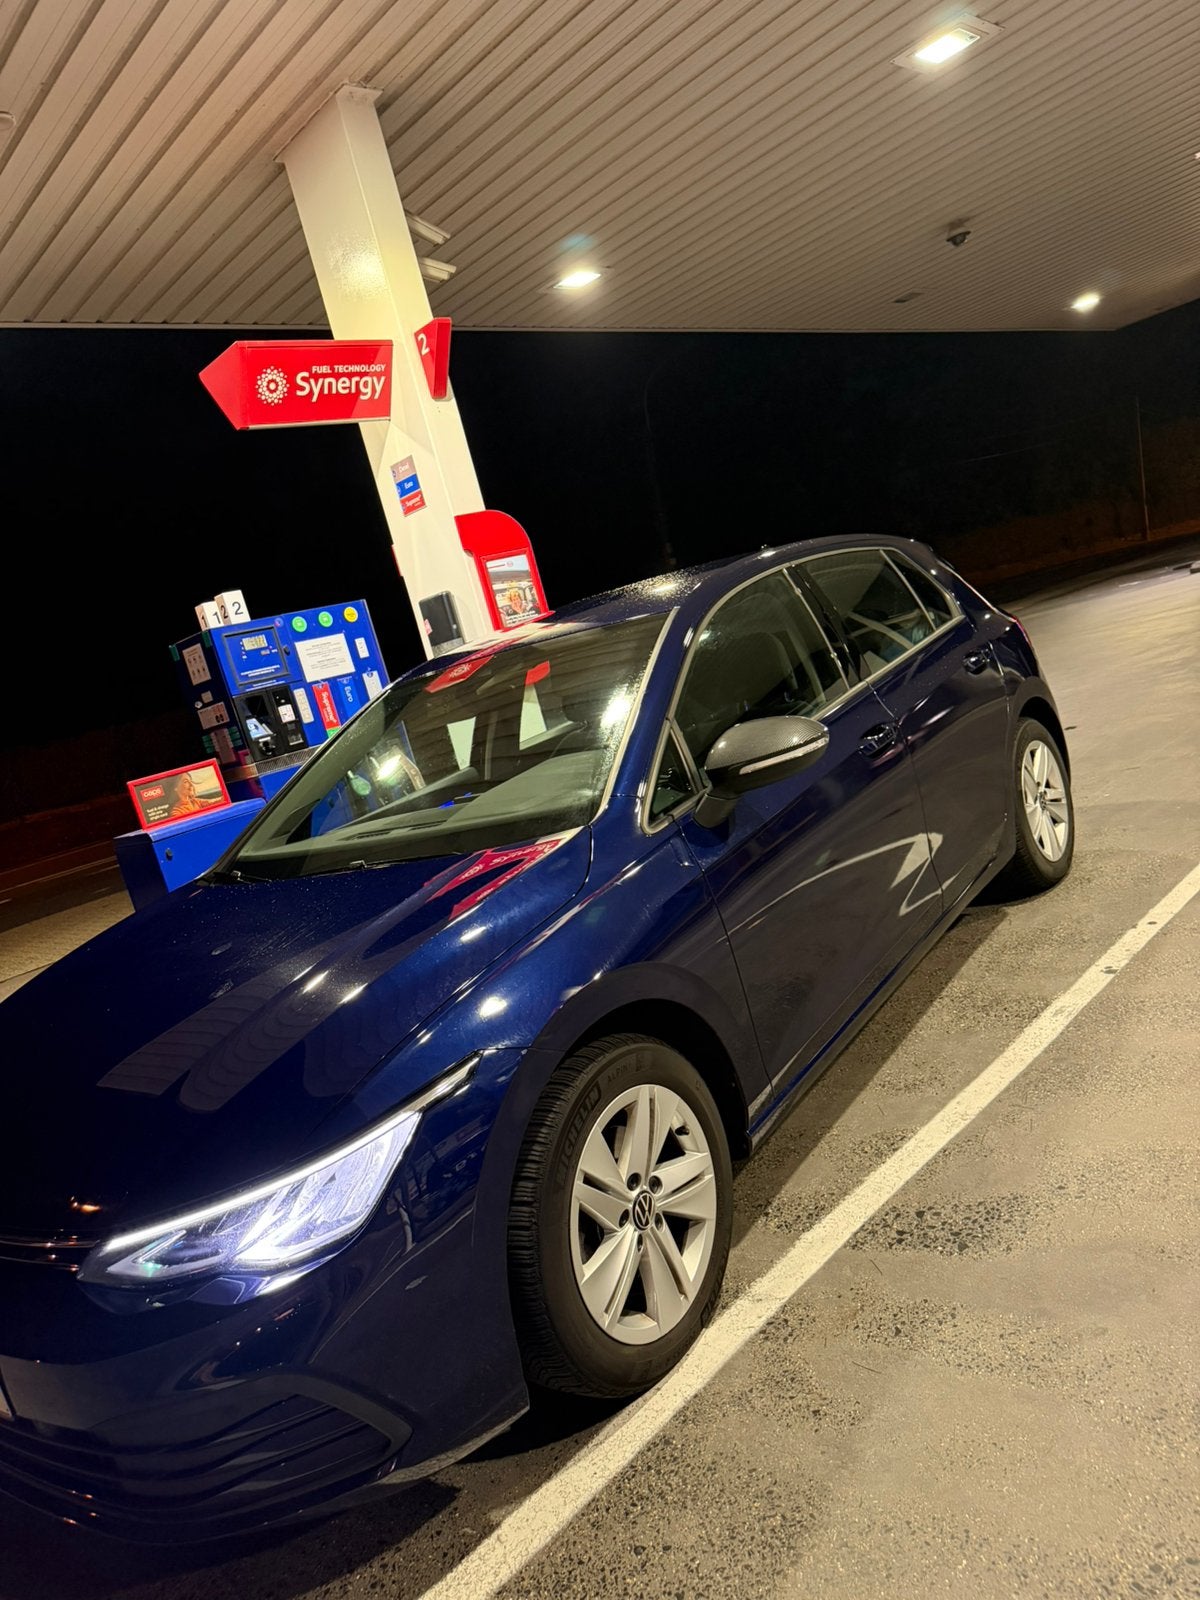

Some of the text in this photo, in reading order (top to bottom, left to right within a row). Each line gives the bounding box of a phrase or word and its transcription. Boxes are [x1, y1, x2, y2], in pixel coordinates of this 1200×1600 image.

[417, 333, 430, 355] 2
[312, 364, 386, 373] FUEL TECHNOLOGY
[296, 371, 386, 403] Synergy
[220, 604, 229, 619] 2
[232, 601, 243, 615] 2
[212, 611, 221, 624] 1
[344, 686, 353, 703] Euro
[558, 1082, 600, 1184] MICHELIN
